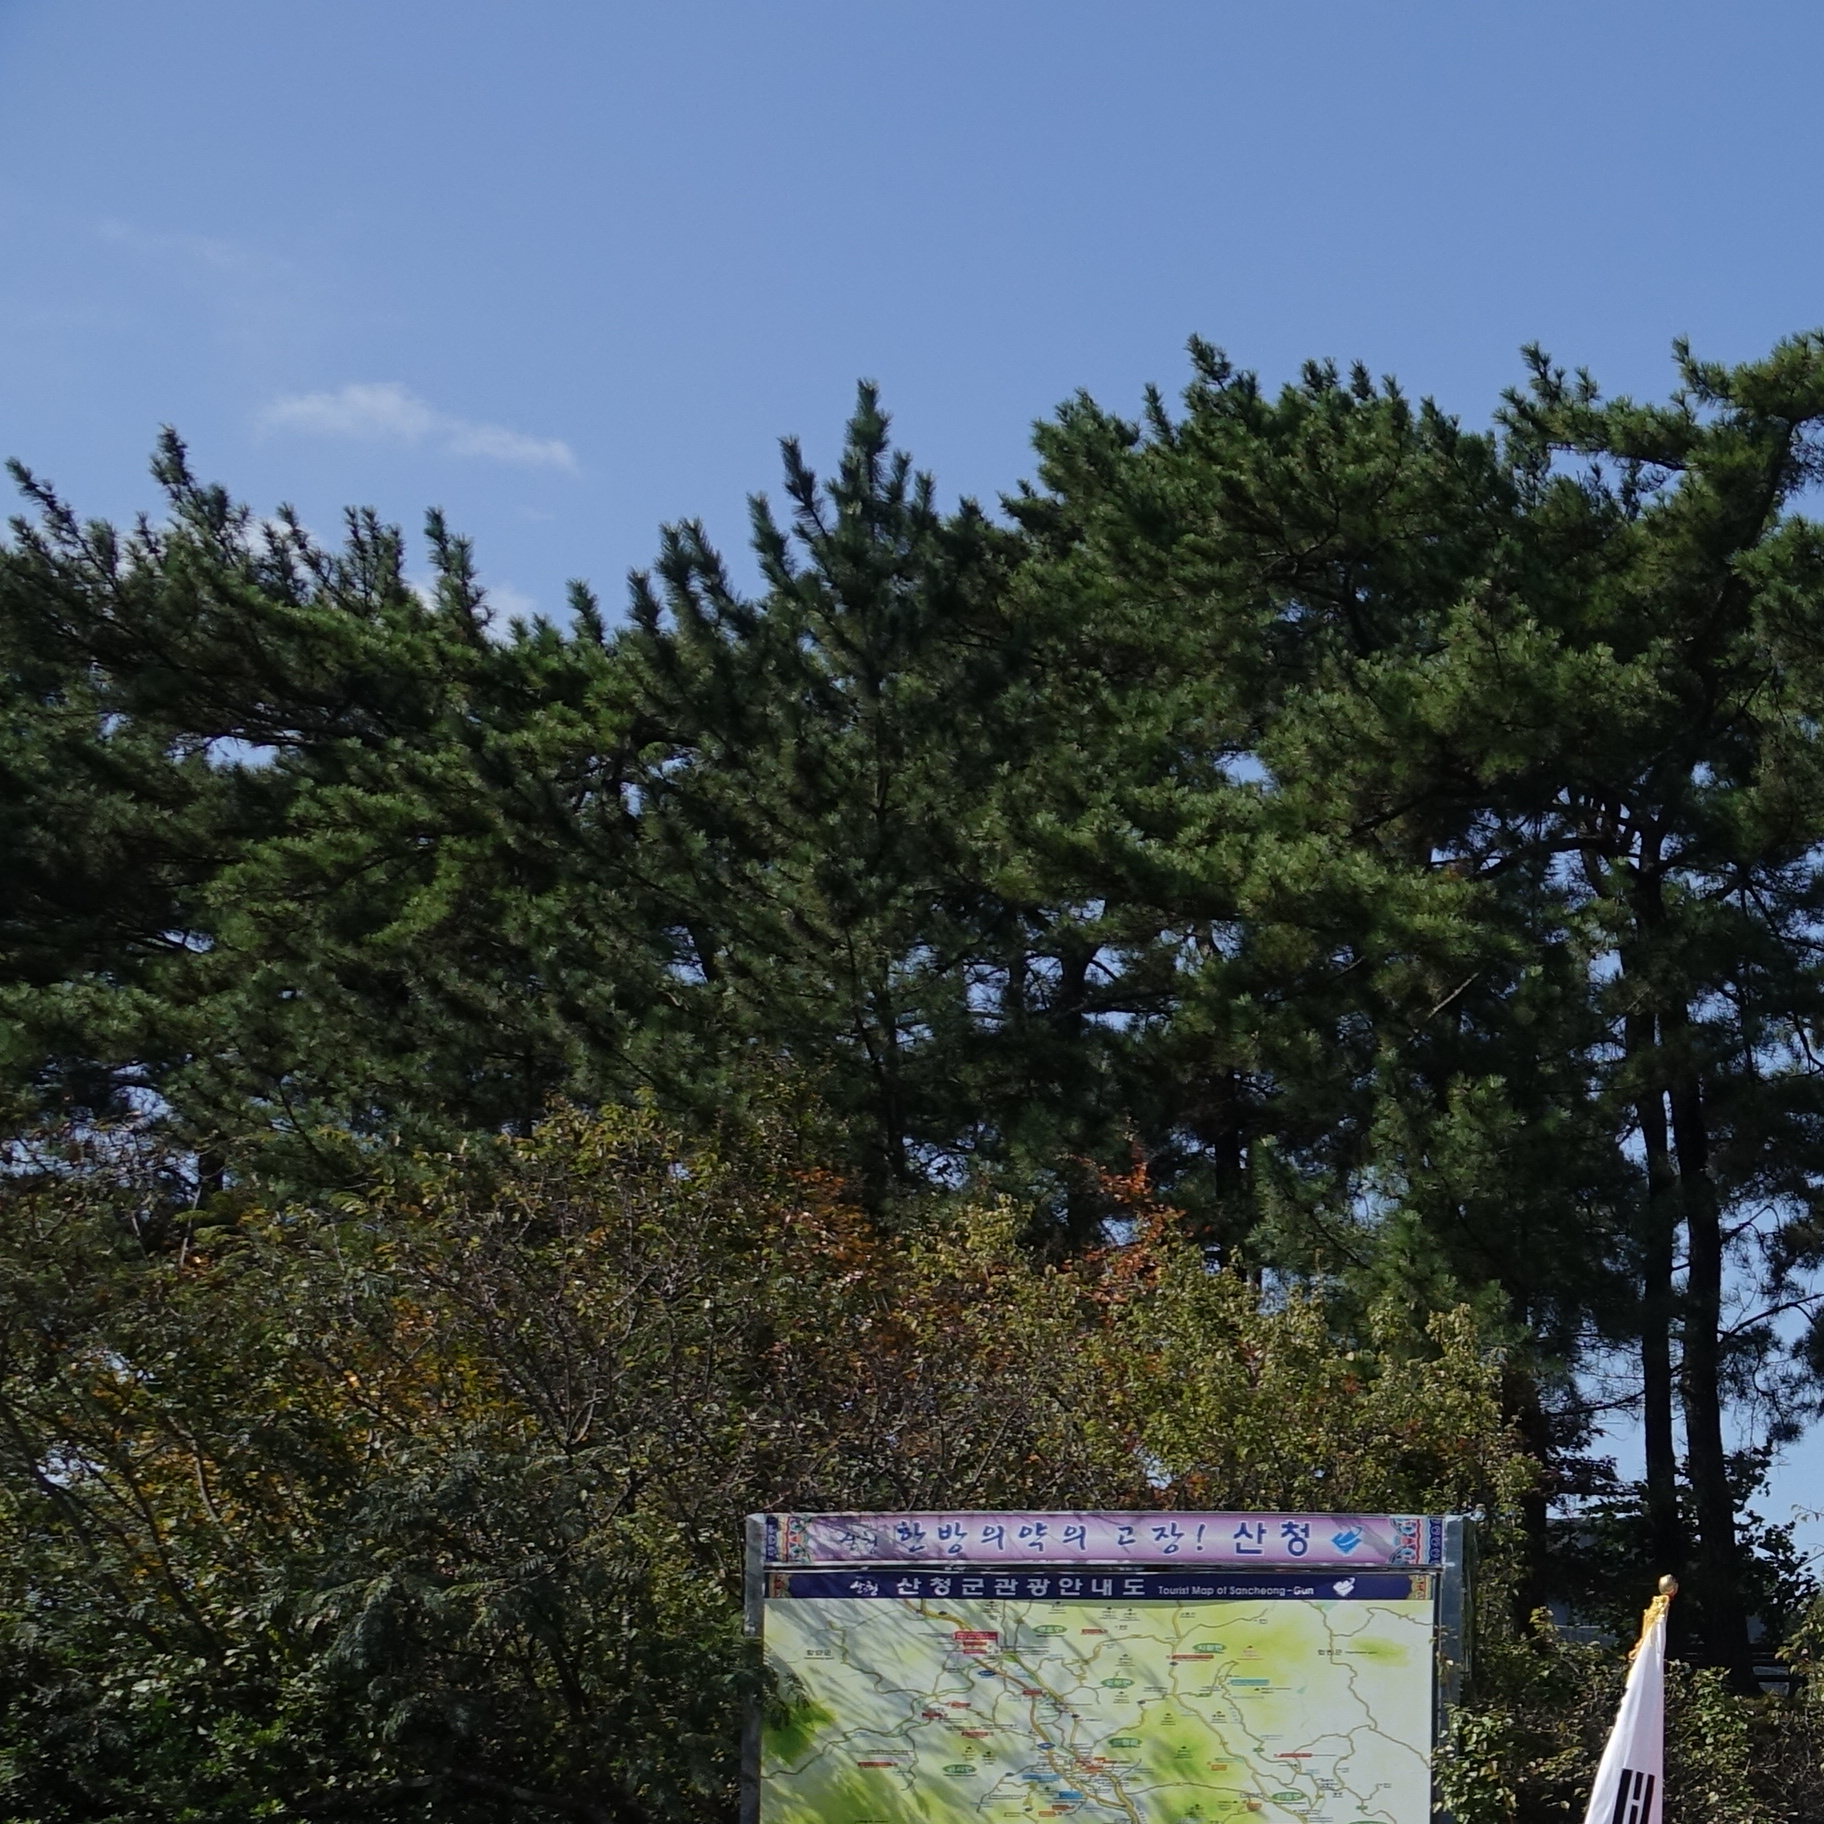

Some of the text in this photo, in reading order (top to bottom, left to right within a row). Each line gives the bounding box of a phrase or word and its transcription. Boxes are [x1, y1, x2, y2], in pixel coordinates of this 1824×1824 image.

[896, 1520, 1311, 1557] 한방의약의 고장! 산청
[897, 1576, 1146, 1597] 산청군관광안내도
[1158, 1585, 1315, 1598] Tourist Map of Sancheong-Gun
